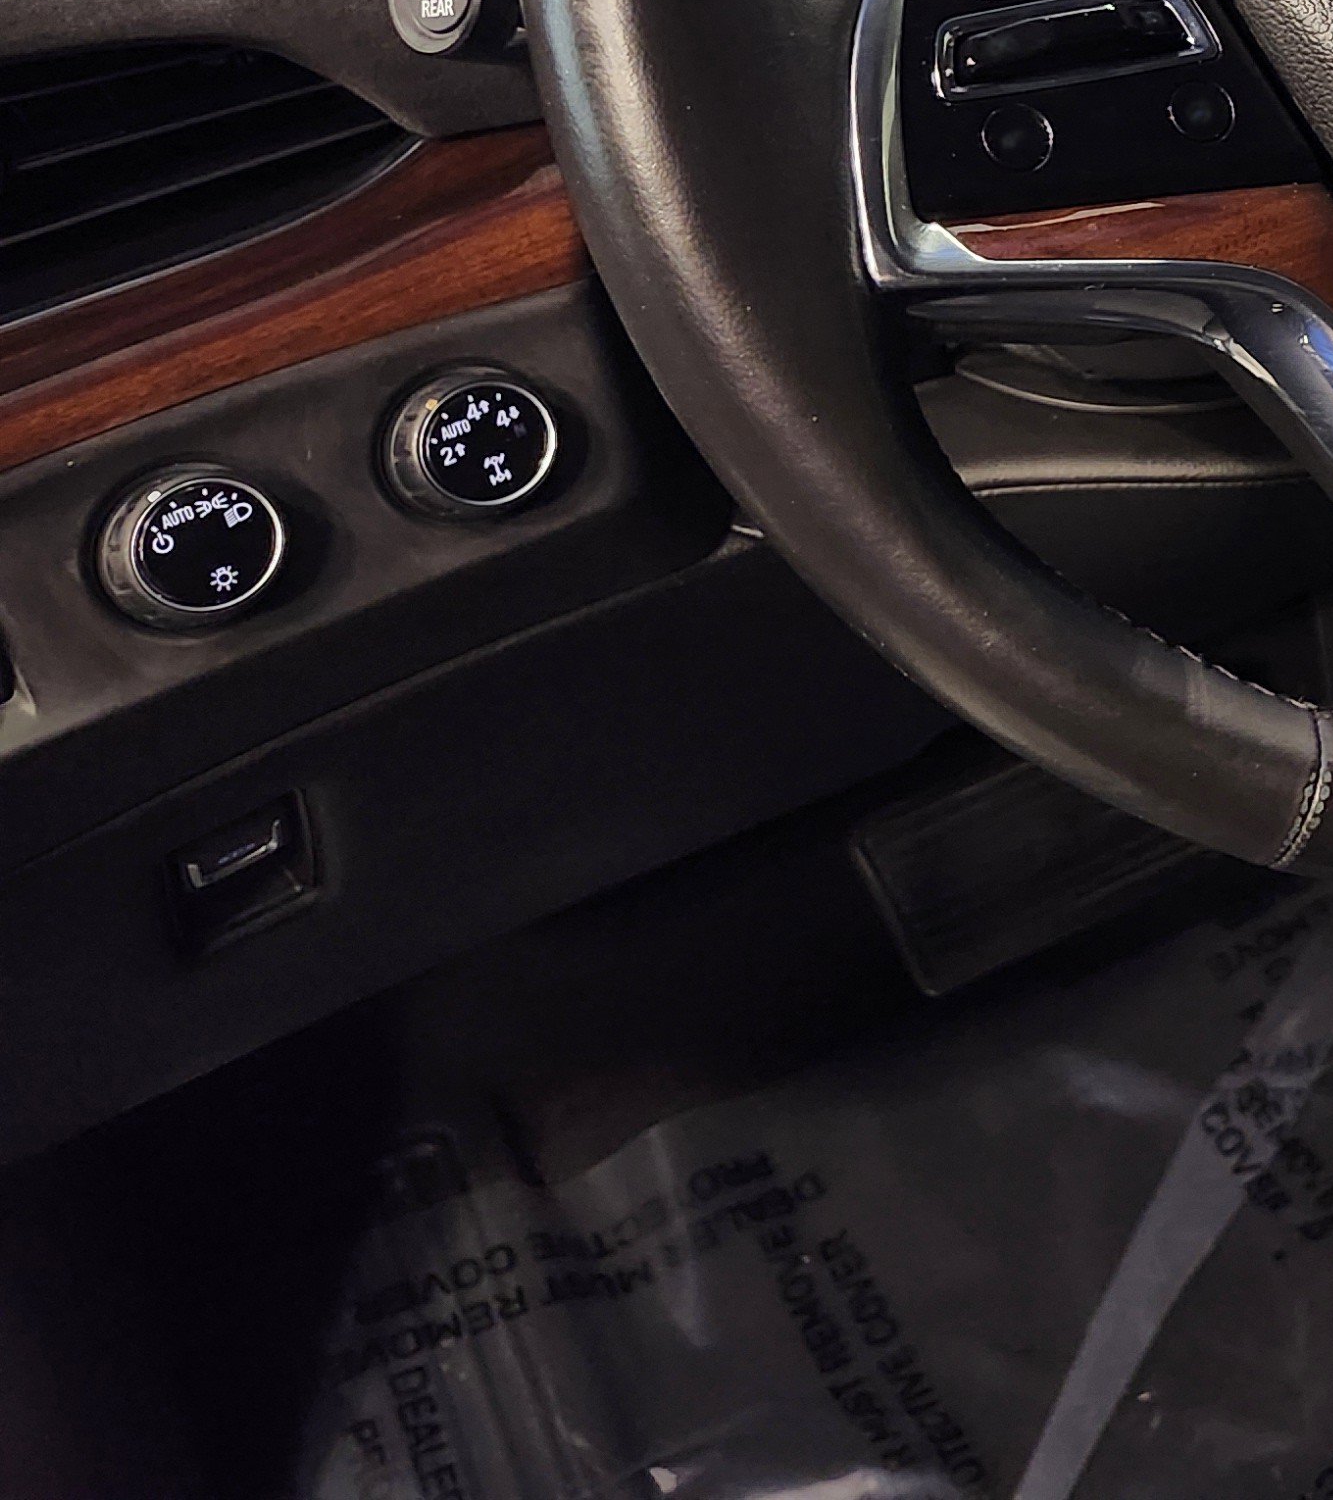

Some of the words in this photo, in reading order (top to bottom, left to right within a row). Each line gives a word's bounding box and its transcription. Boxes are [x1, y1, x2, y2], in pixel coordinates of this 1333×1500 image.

[467, 402, 482, 421] 4
[496, 409, 511, 428] 4
[440, 418, 472, 442] AUTO
[440, 446, 458, 467] 2
[161, 505, 195, 530] AUTO
